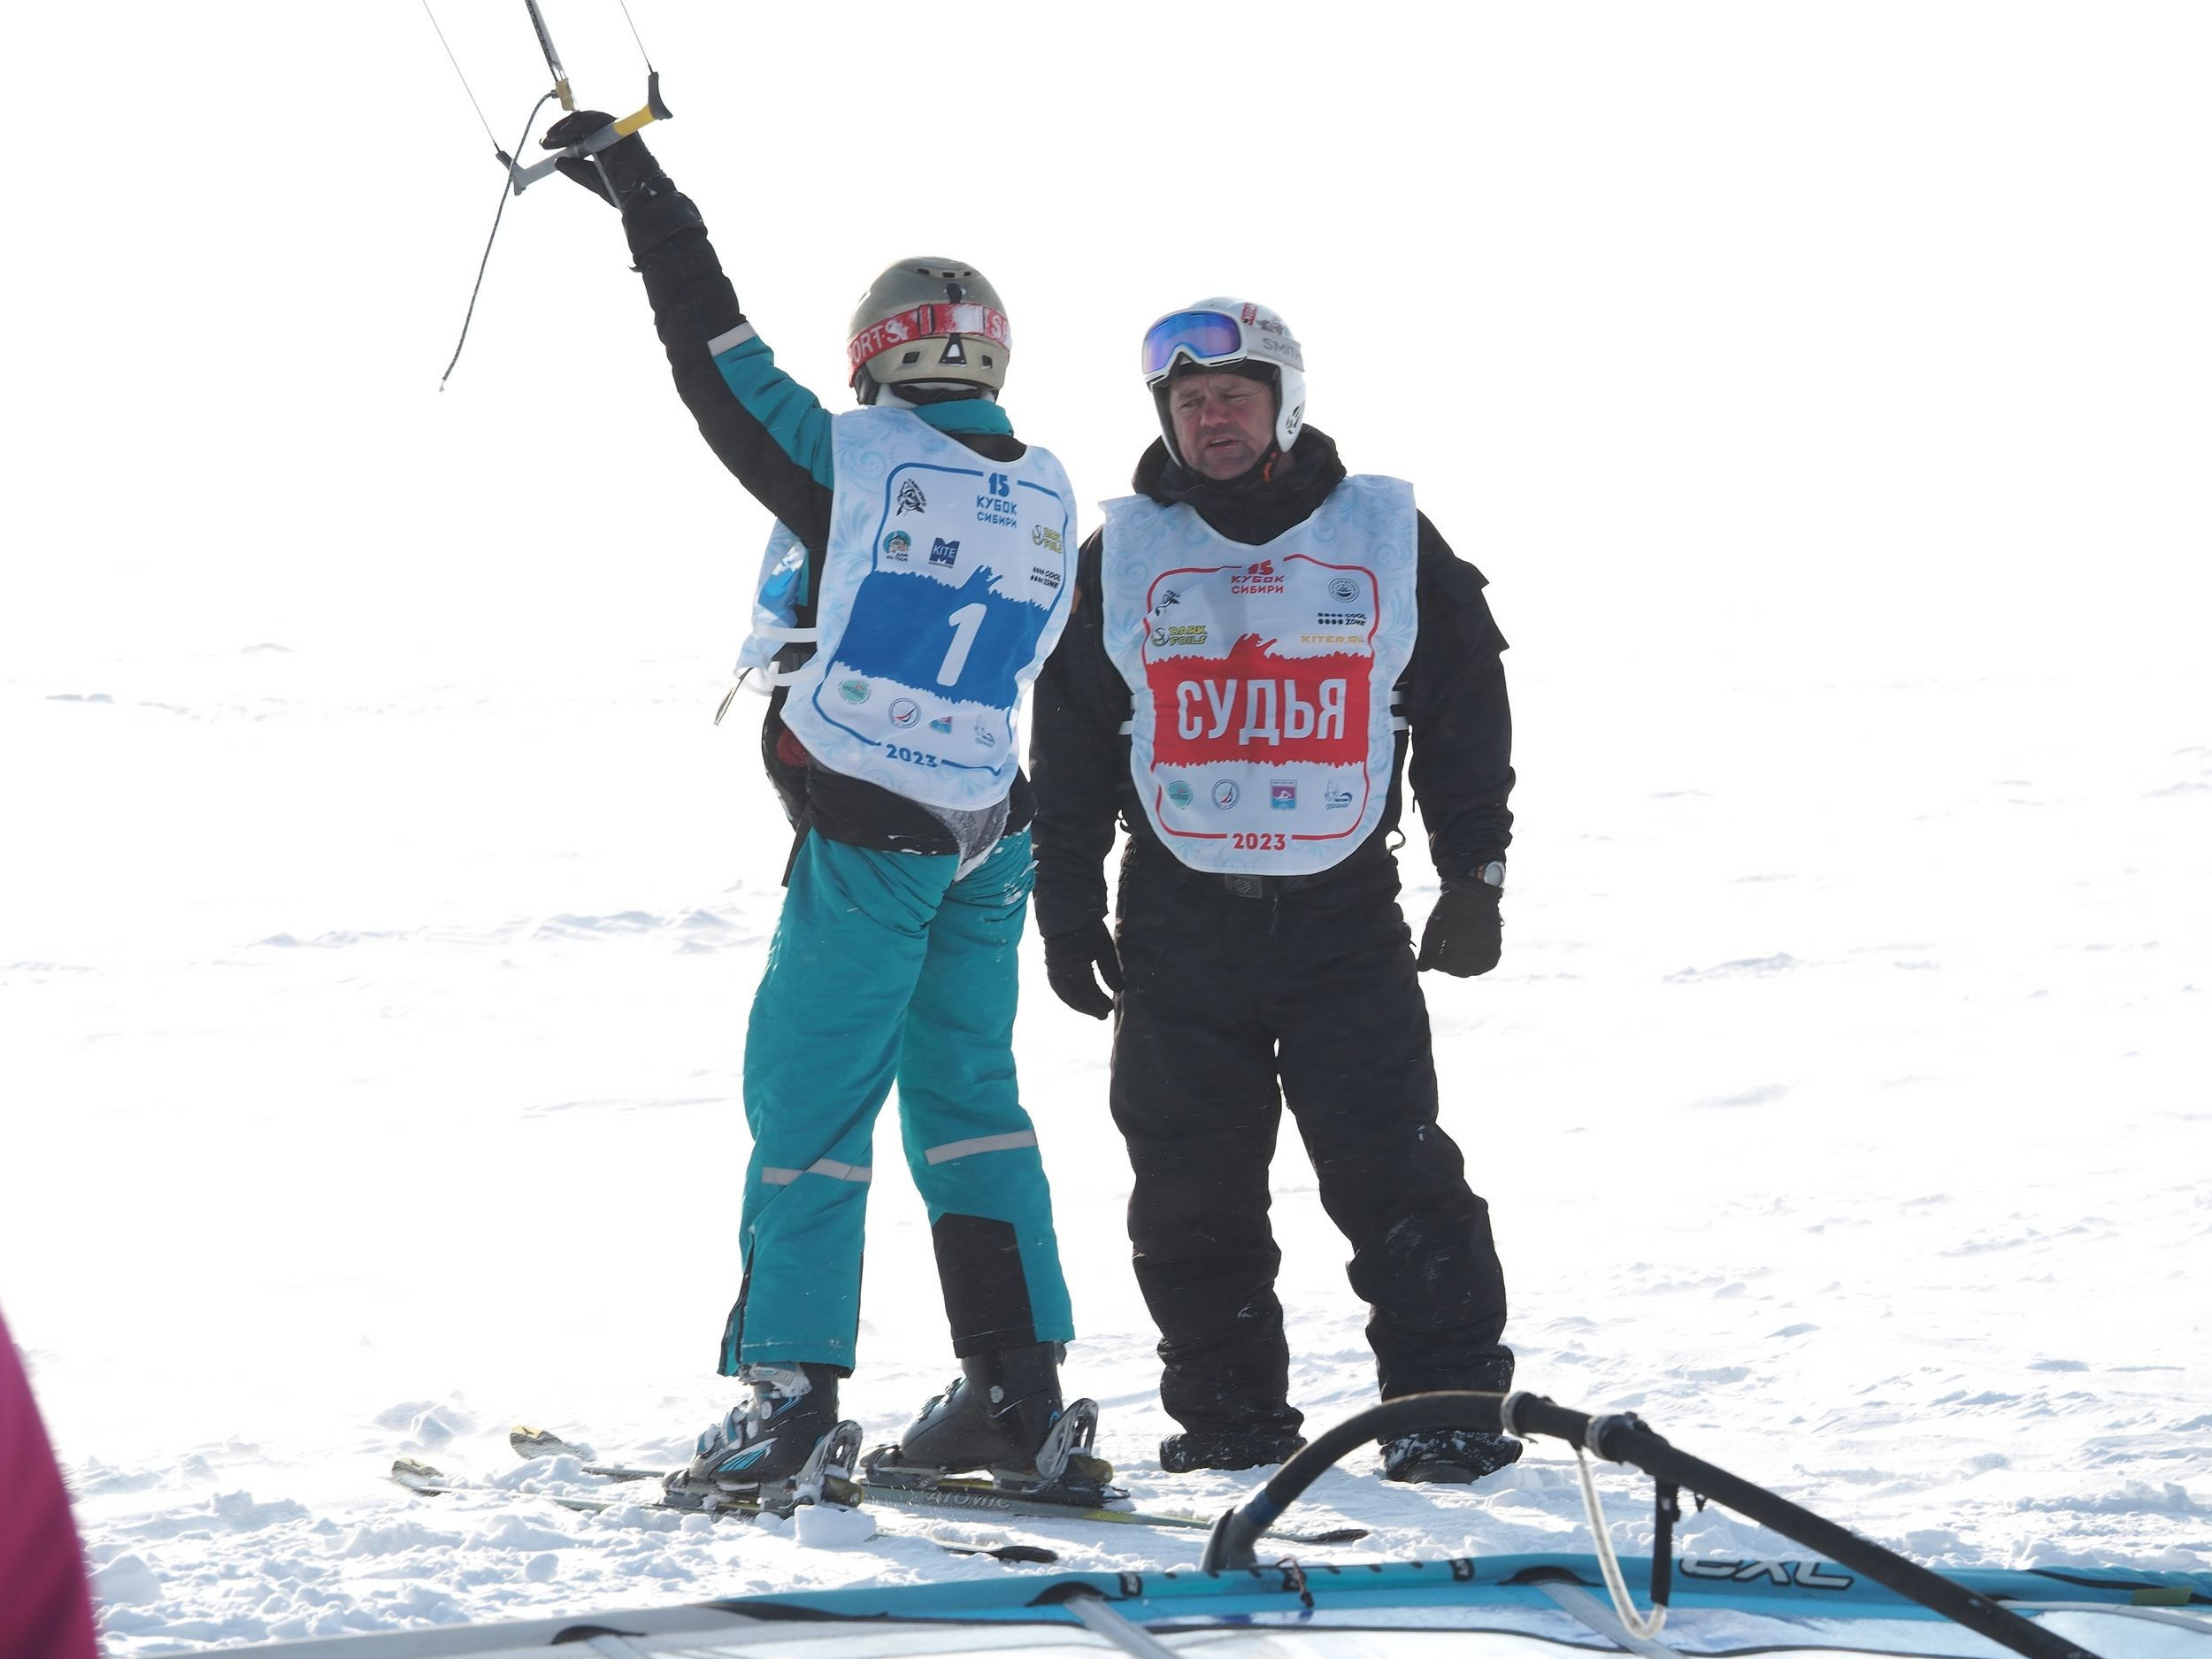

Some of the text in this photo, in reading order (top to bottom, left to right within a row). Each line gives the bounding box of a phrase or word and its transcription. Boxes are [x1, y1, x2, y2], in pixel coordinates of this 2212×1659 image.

[847, 319, 902, 364] ORTS
[988, 472, 1010, 497] 15
[976, 495, 1017, 515] КУБОК
[976, 511, 1017, 528] СИБИРИ
[933, 544, 956, 558] KITE
[1045, 570, 1062, 582] COOL
[1247, 559, 1274, 575] 15
[1169, 625, 1207, 635] DARK
[936, 603, 987, 687] 1
[1169, 635, 1207, 646] FOILS
[1176, 679, 1348, 746] СУДЬЯ
[886, 743, 939, 768] 2023
[1233, 833, 1286, 850] 2023
[926, 1488, 1010, 1509] ATOMIC
